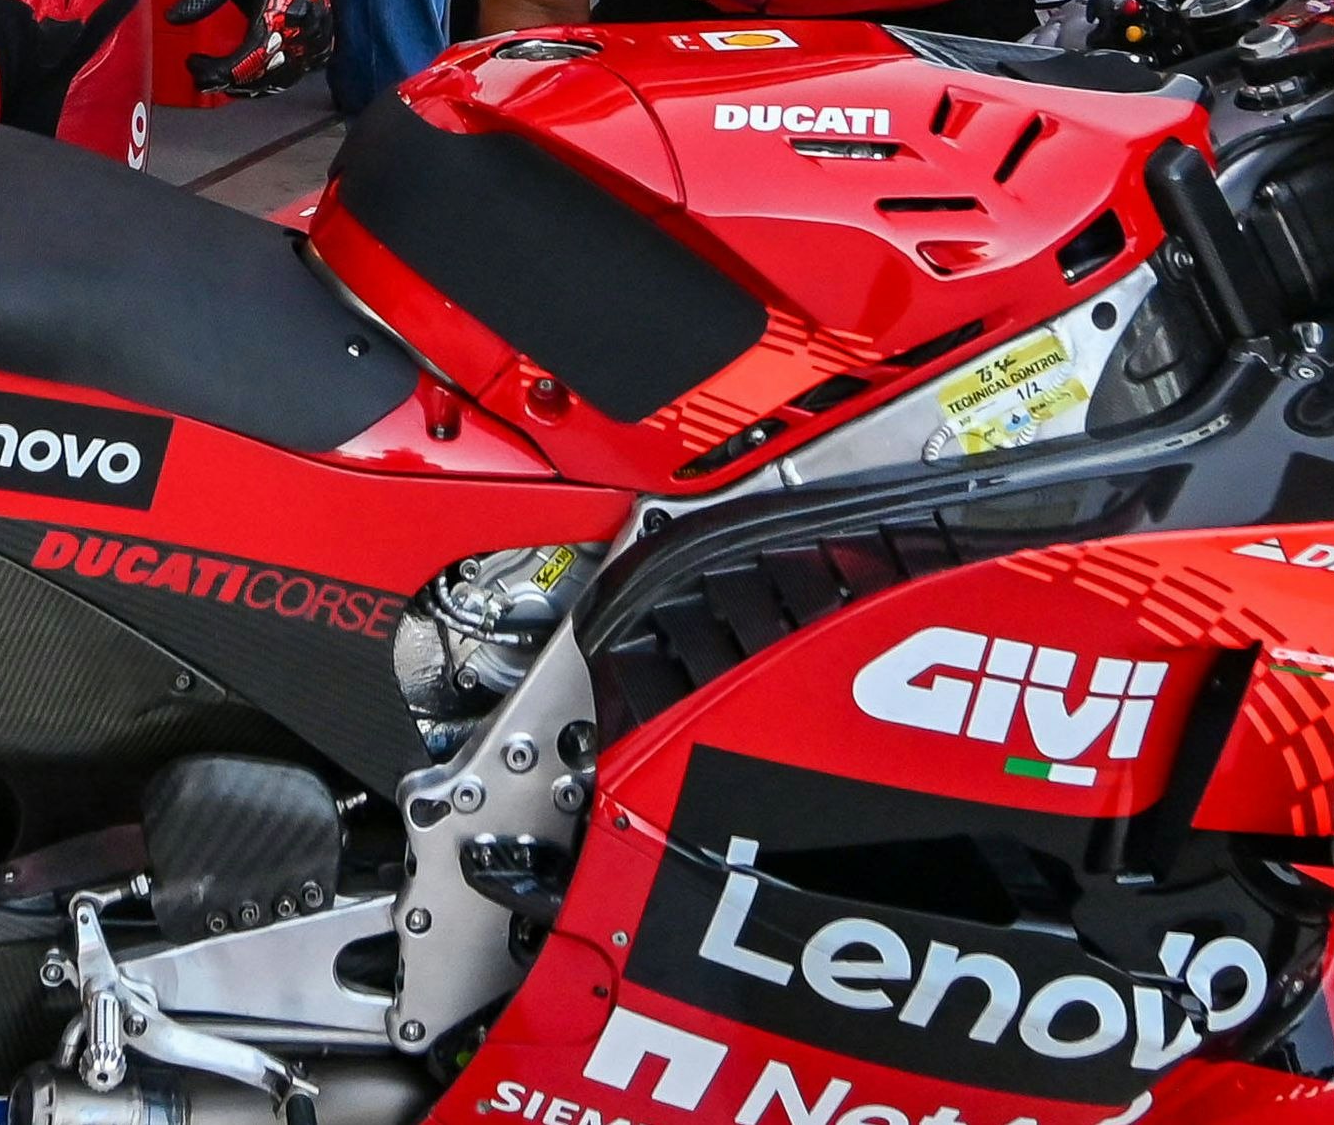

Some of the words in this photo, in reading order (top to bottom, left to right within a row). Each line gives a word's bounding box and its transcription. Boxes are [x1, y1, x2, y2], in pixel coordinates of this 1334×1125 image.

[713, 103, 891, 136] DUCATI
[948, 379, 1012, 415] TECHNICAL
[1009, 351, 1065, 385] CONTROL
[853, 626, 1169, 760] GIVI
[698, 835, 1268, 1071] Lenovo
